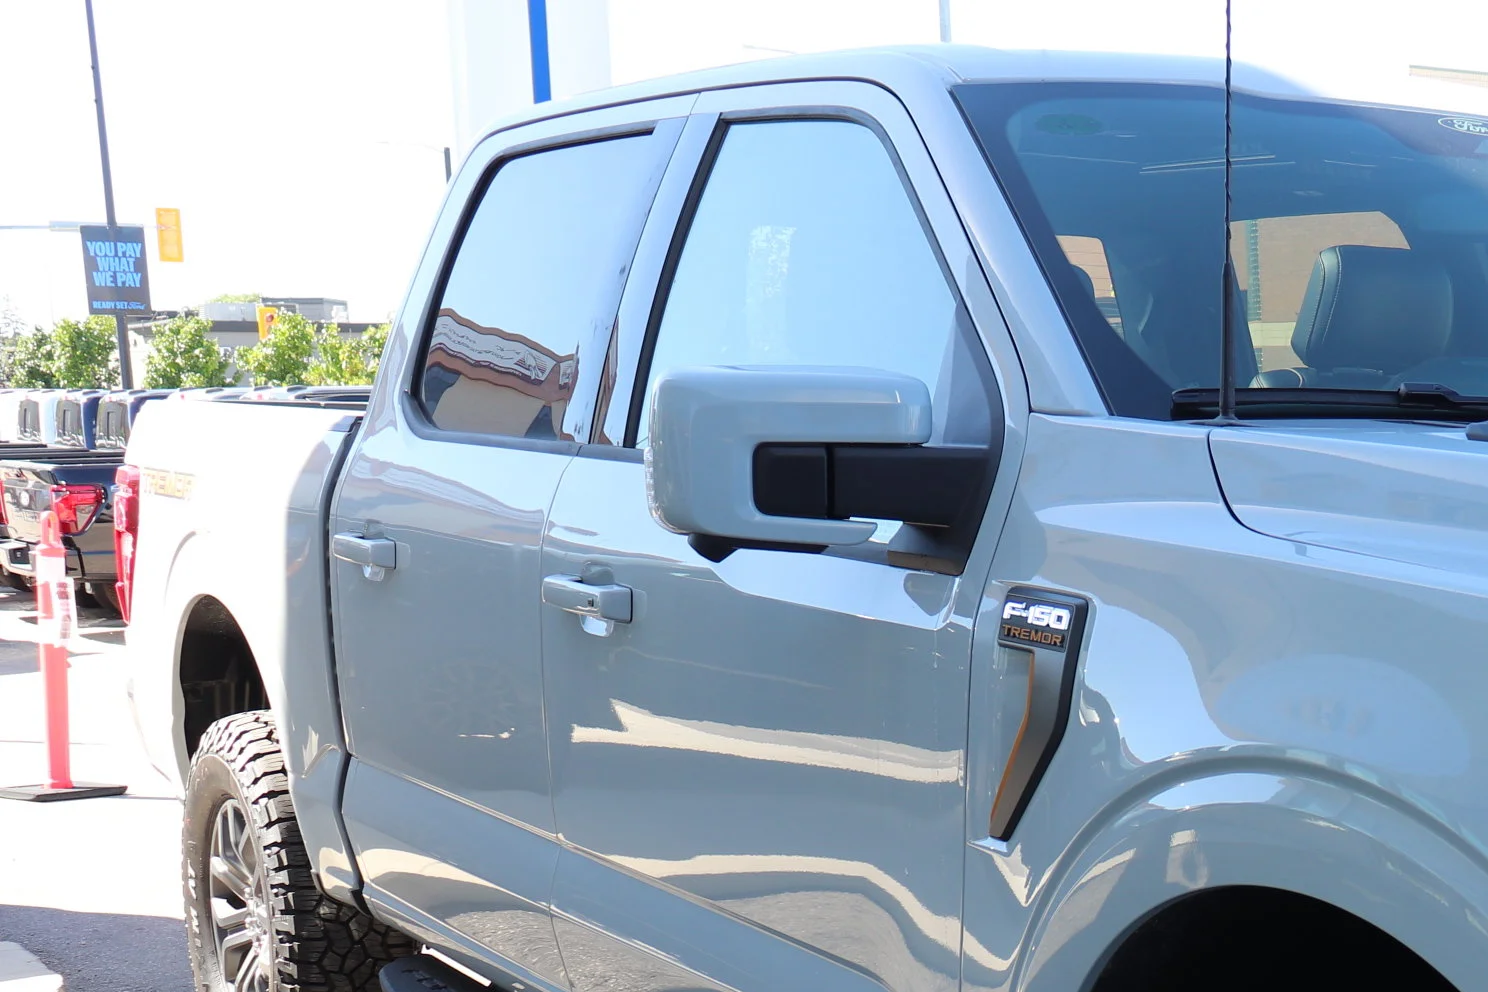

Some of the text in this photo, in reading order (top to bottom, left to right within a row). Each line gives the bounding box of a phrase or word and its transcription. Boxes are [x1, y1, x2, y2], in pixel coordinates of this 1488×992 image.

[86, 241, 142, 257] YOU PAY
[96, 257, 136, 272] WHAT
[92, 271, 142, 288] WE PAY
[92, 301, 115, 309] READY
[116, 301, 128, 310] SET
[1002, 601, 1071, 631] F-150
[1002, 624, 1063, 647] TREMOR
